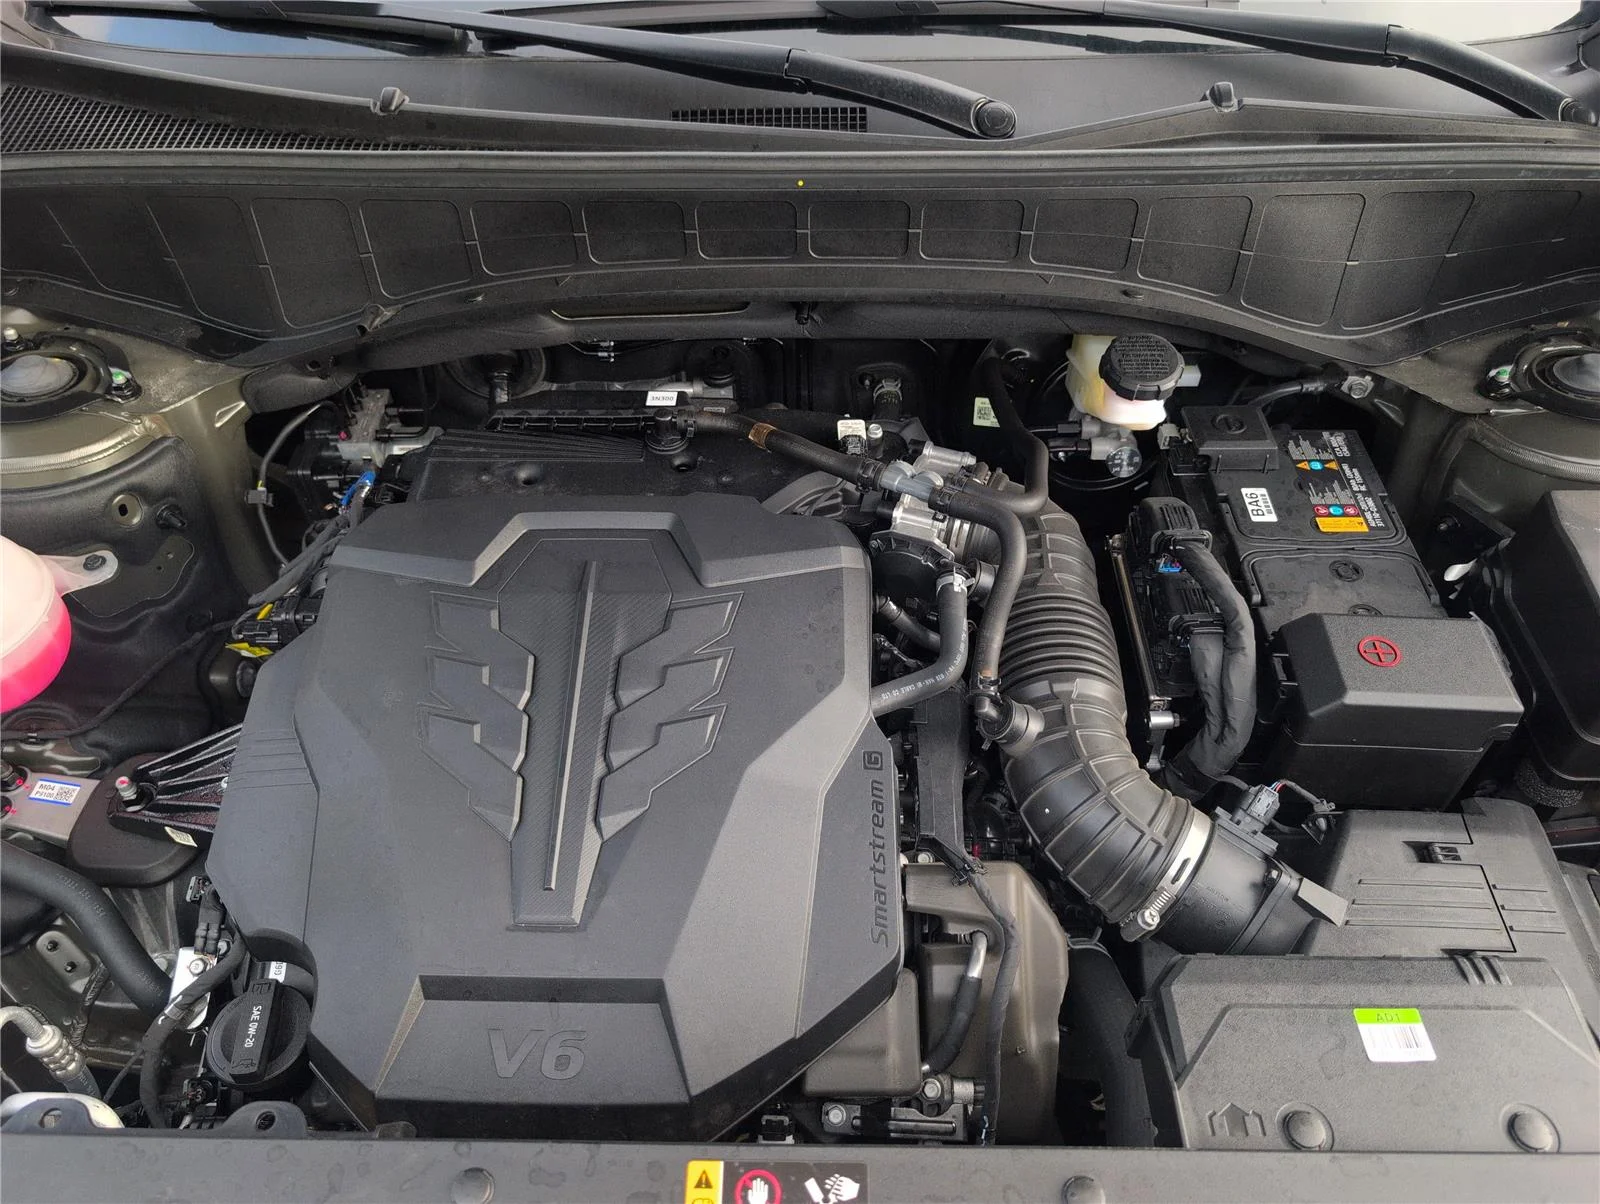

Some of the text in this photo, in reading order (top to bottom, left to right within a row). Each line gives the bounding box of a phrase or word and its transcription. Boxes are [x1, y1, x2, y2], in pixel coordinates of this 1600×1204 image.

[1245, 492, 1265, 516] BA6
[869, 779, 889, 948] Smartstream
[244, 1005, 262, 1048] SAE 0W-20
[486, 1027, 588, 1081] V6
